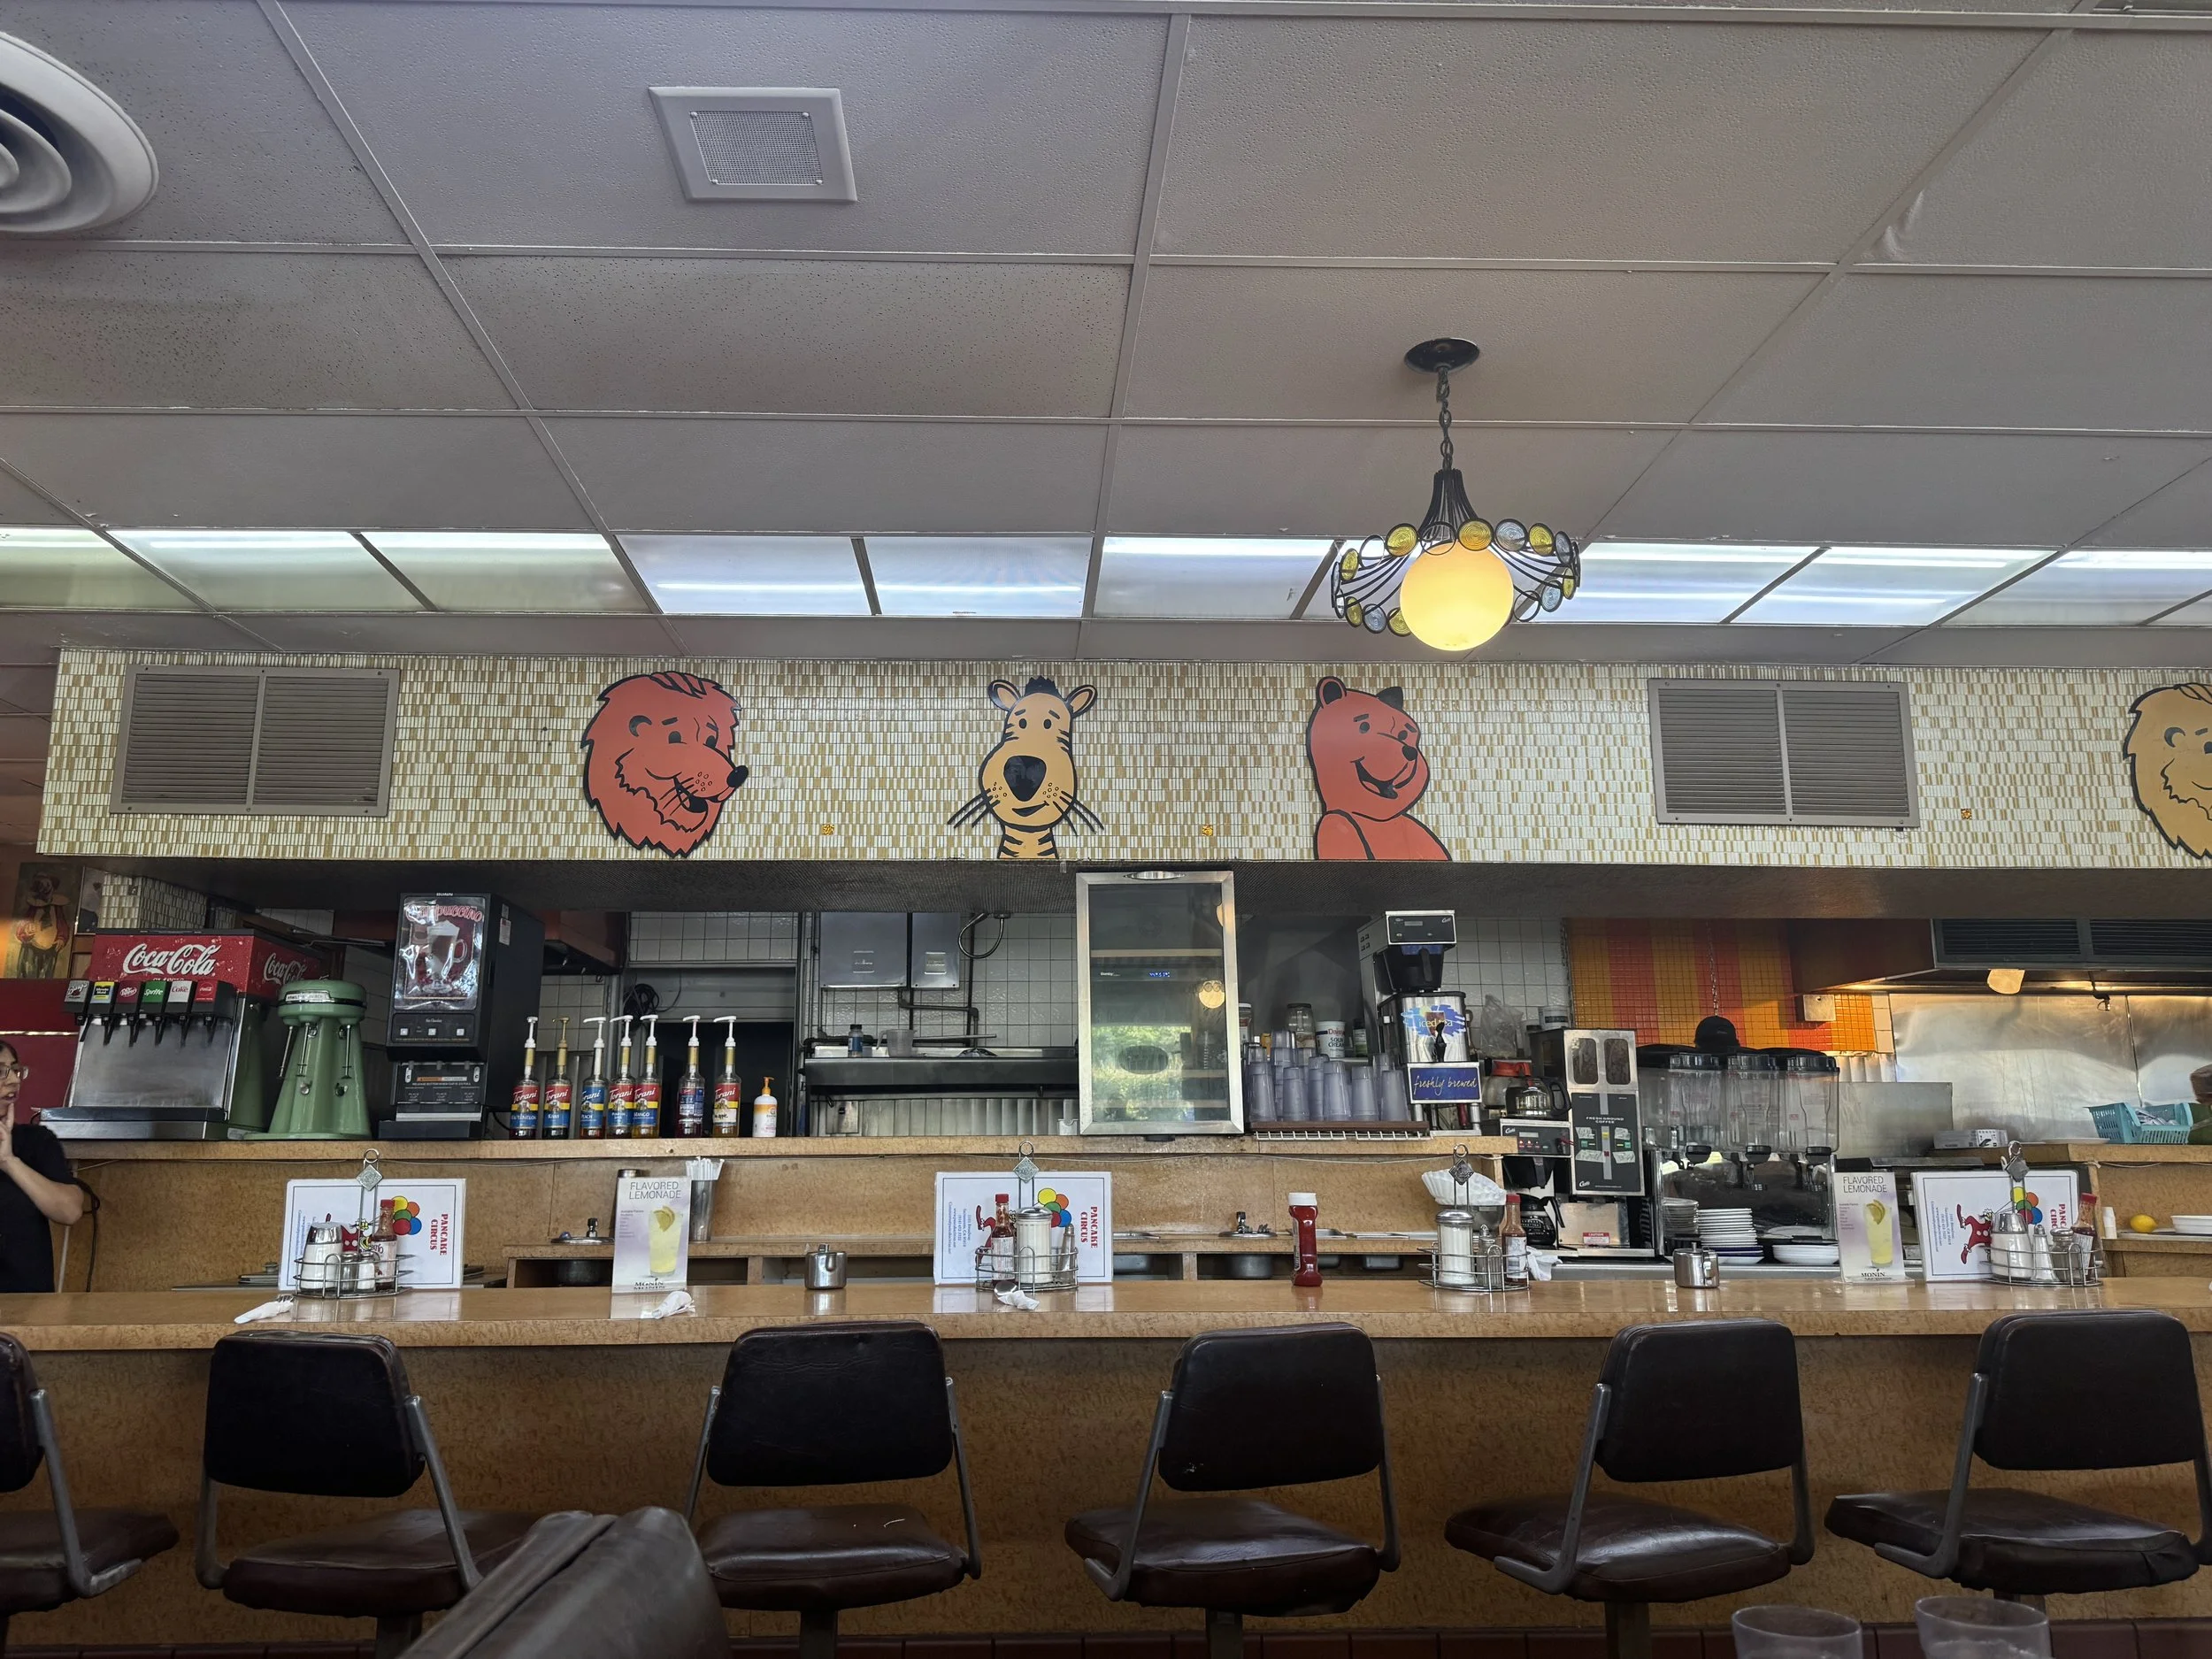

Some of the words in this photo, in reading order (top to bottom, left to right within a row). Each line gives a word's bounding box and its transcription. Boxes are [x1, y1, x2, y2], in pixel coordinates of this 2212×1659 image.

[122, 942, 222, 975] Coca-Cola
[264, 952, 308, 986] Coca-Col
[1418, 1018, 1437, 1027] iced
[1413, 1075, 1445, 1096] freshly
[1448, 1077, 1478, 1088] brewed
[513, 1089, 538, 1103] Torani
[545, 1089, 569, 1102] Torani
[610, 1088, 633, 1102] Torani
[630, 1181, 679, 1190] FLAVORED
[1843, 1176, 1884, 1185] FLAVORED
[629, 1190, 681, 1200] LEMONADE
[1843, 1185, 1887, 1194] LEMONADE
[2049, 1209, 2058, 1228] CIRC
[2058, 1203, 2067, 1228] PANC
[429, 1218, 439, 1250] CIRCUS
[439, 1213, 449, 1256] PANCAKE
